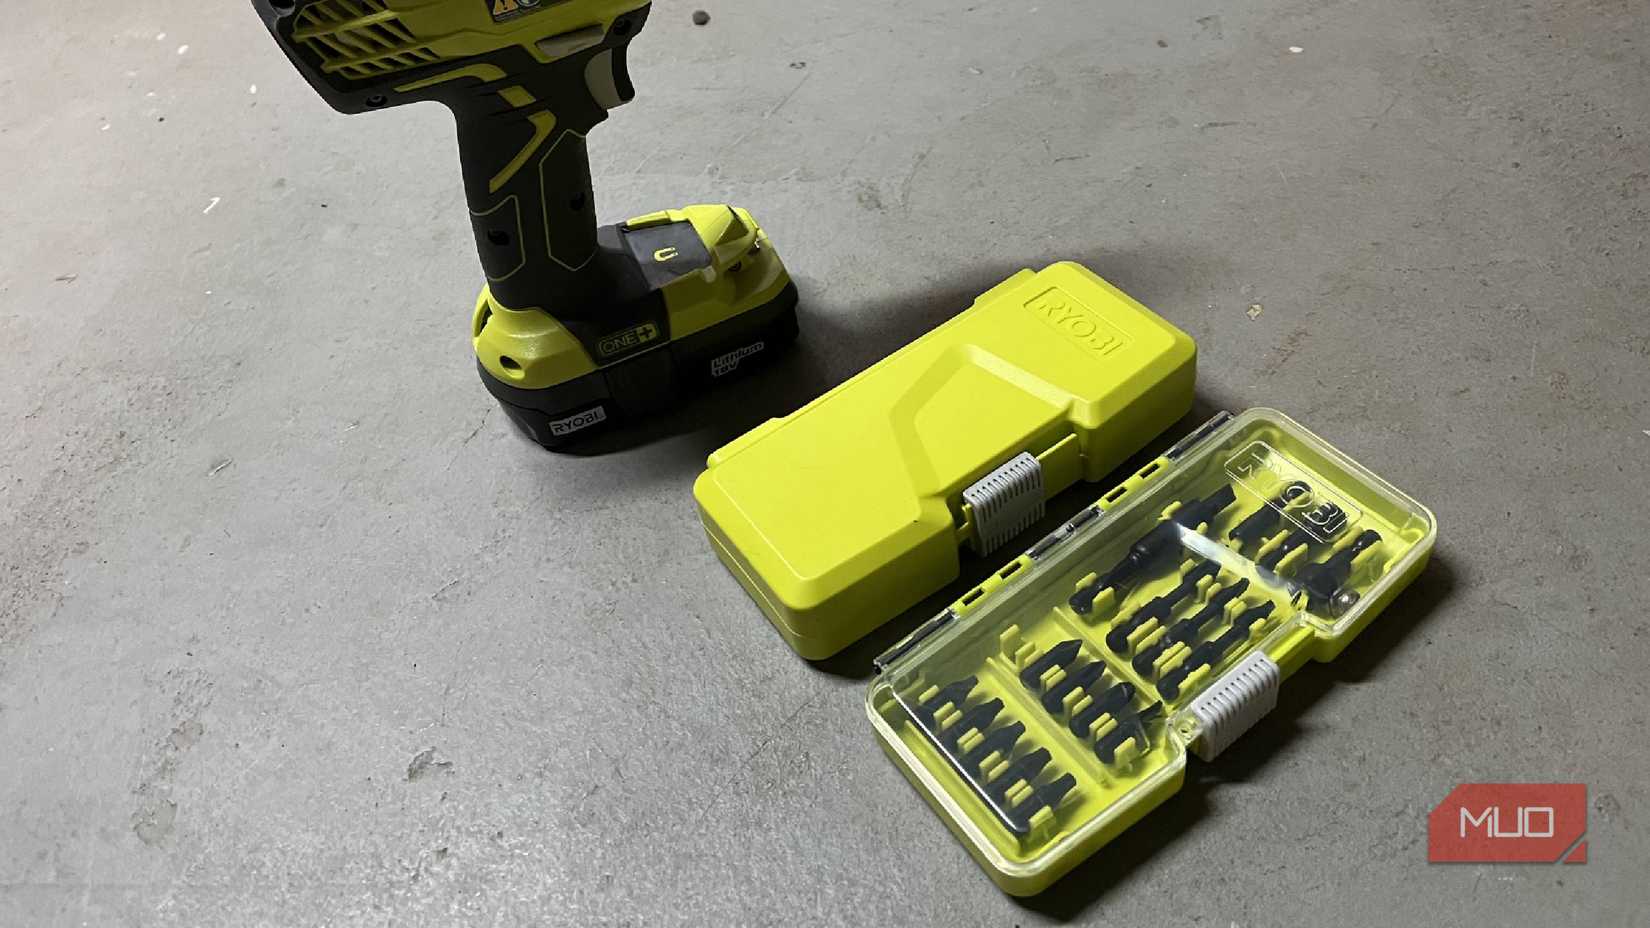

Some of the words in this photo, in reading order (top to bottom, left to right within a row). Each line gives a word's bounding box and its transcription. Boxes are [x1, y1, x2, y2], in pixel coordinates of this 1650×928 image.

[1035, 297, 1125, 357] RYOBI
[552, 408, 601, 434] RYOBI
[1236, 450, 1348, 534] ROBI
